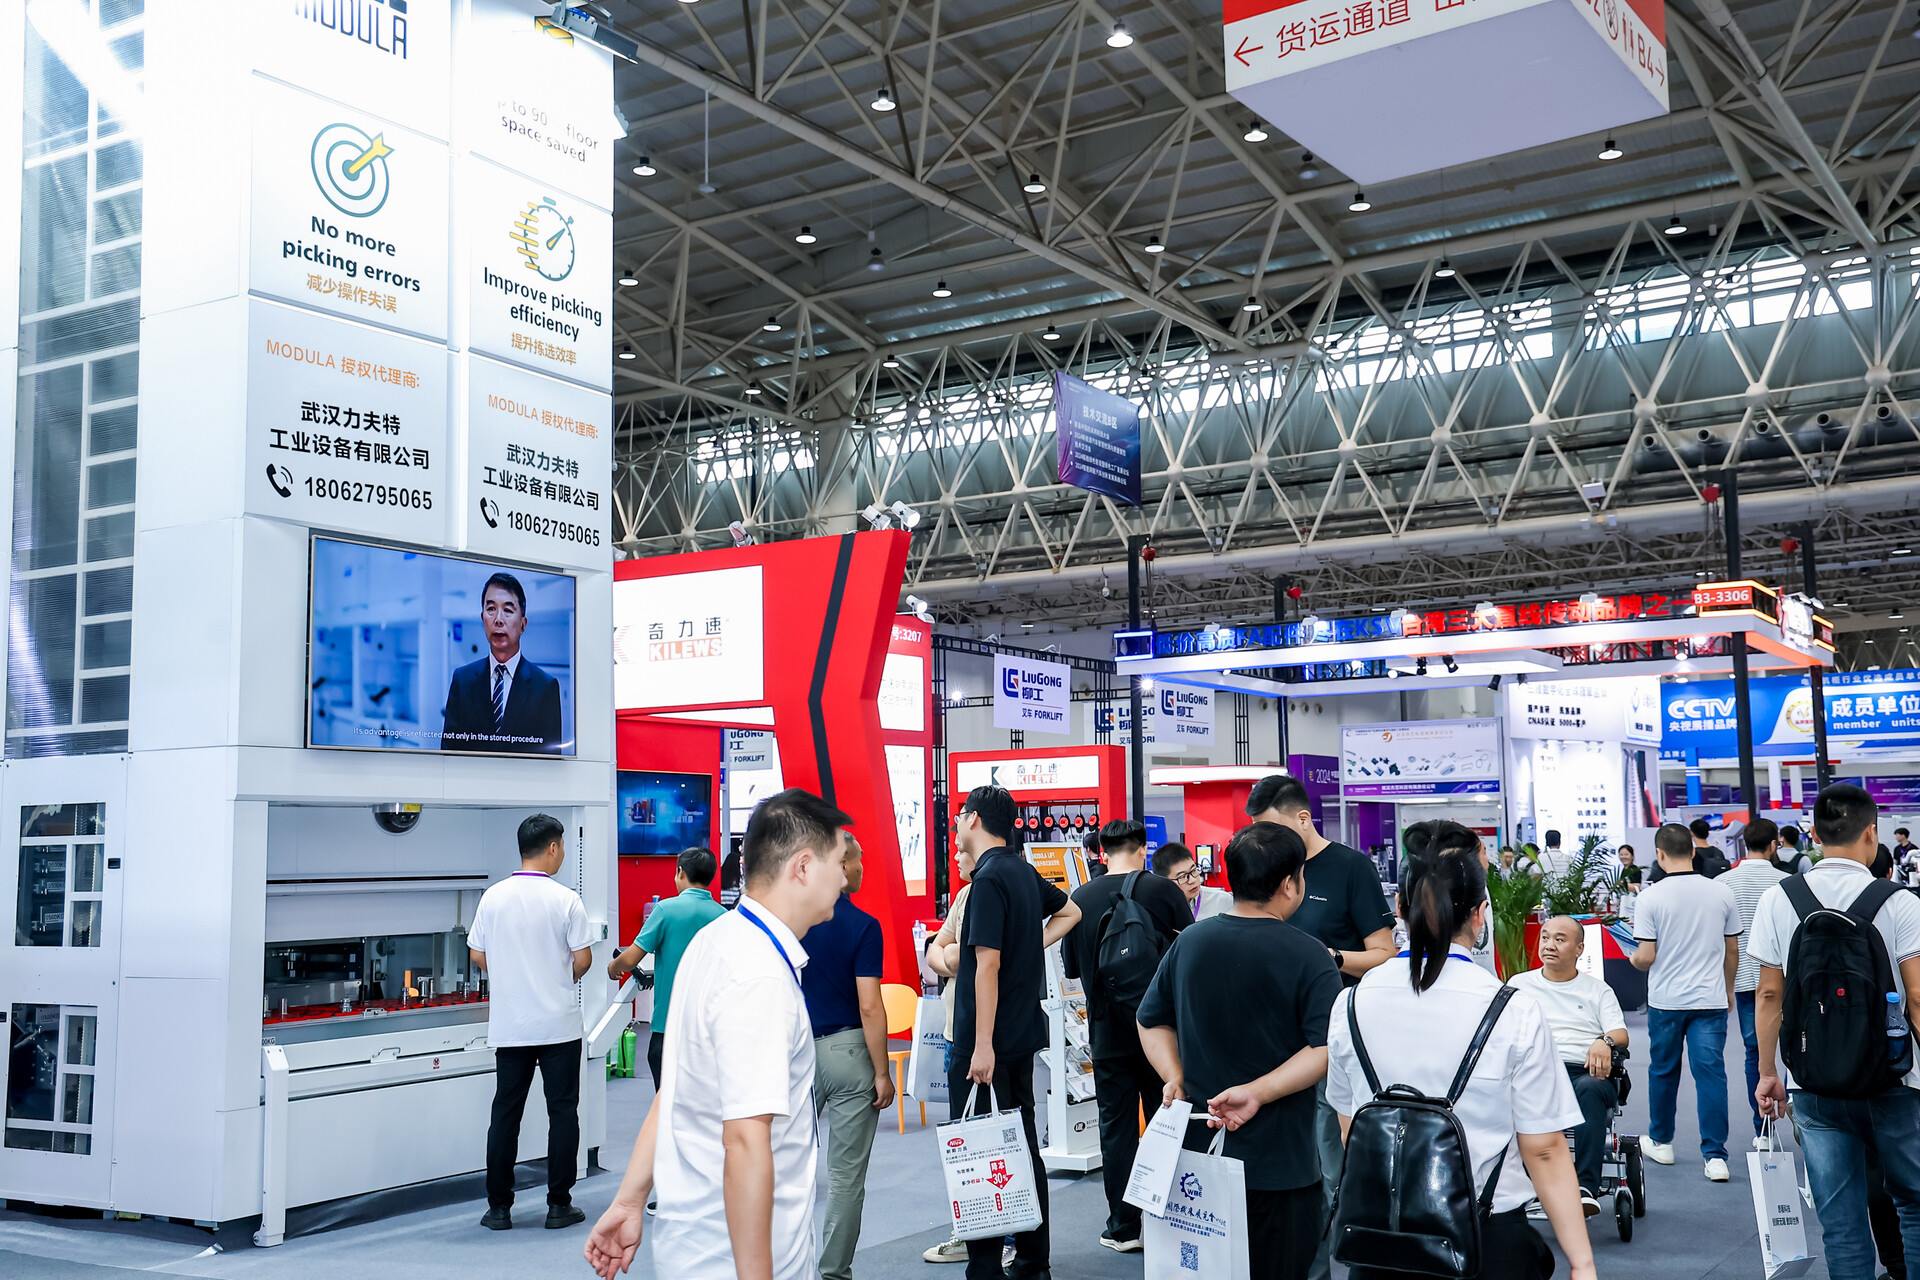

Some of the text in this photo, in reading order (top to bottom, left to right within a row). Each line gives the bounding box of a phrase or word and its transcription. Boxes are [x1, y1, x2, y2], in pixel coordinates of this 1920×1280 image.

[1276, 0, 1411, 58] 货运通道
[501, 116, 586, 163] space saved
[311, 215, 396, 257] No more
[283, 240, 421, 292] picking errors
[306, 273, 398, 313] 减少操作失误
[484, 266, 602, 327] Improve picking
[510, 304, 580, 342] efficiency
[266, 339, 420, 389] MODULA 授权代理商:
[512, 331, 577, 365] 提升拣选效率
[301, 401, 401, 436] 武汉力夫特
[488, 394, 599, 439] MODULA 授权代理商:
[269, 428, 430, 470] 工业设备有限公司
[506, 443, 579, 479] 武汉力夫特
[304, 476, 433, 510] 18062795065
[483, 466, 599, 511] 工业设备有限公司
[507, 510, 600, 547] 18062795065
[1694, 589, 1750, 605] B3-3306
[649, 617, 721, 640] 奇力速
[649, 637, 722, 662] KILEWS
[1022, 686, 1044, 701] 柳工
[1667, 697, 1736, 719] CCTV
[1832, 694, 1920, 718] 成员单位
[1034, 709, 1063, 721] FORKLIFT
[1186, 724, 1209, 735] FORKLIFT
[1833, 716, 1920, 730] member units
[455, 732, 469, 742] only
[470, 732, 477, 740] in
[477, 733, 489, 741] the
[489, 734, 511, 742] stored
[511, 735, 544, 744] procedure
[734, 754, 765, 763] FORKLIFT
